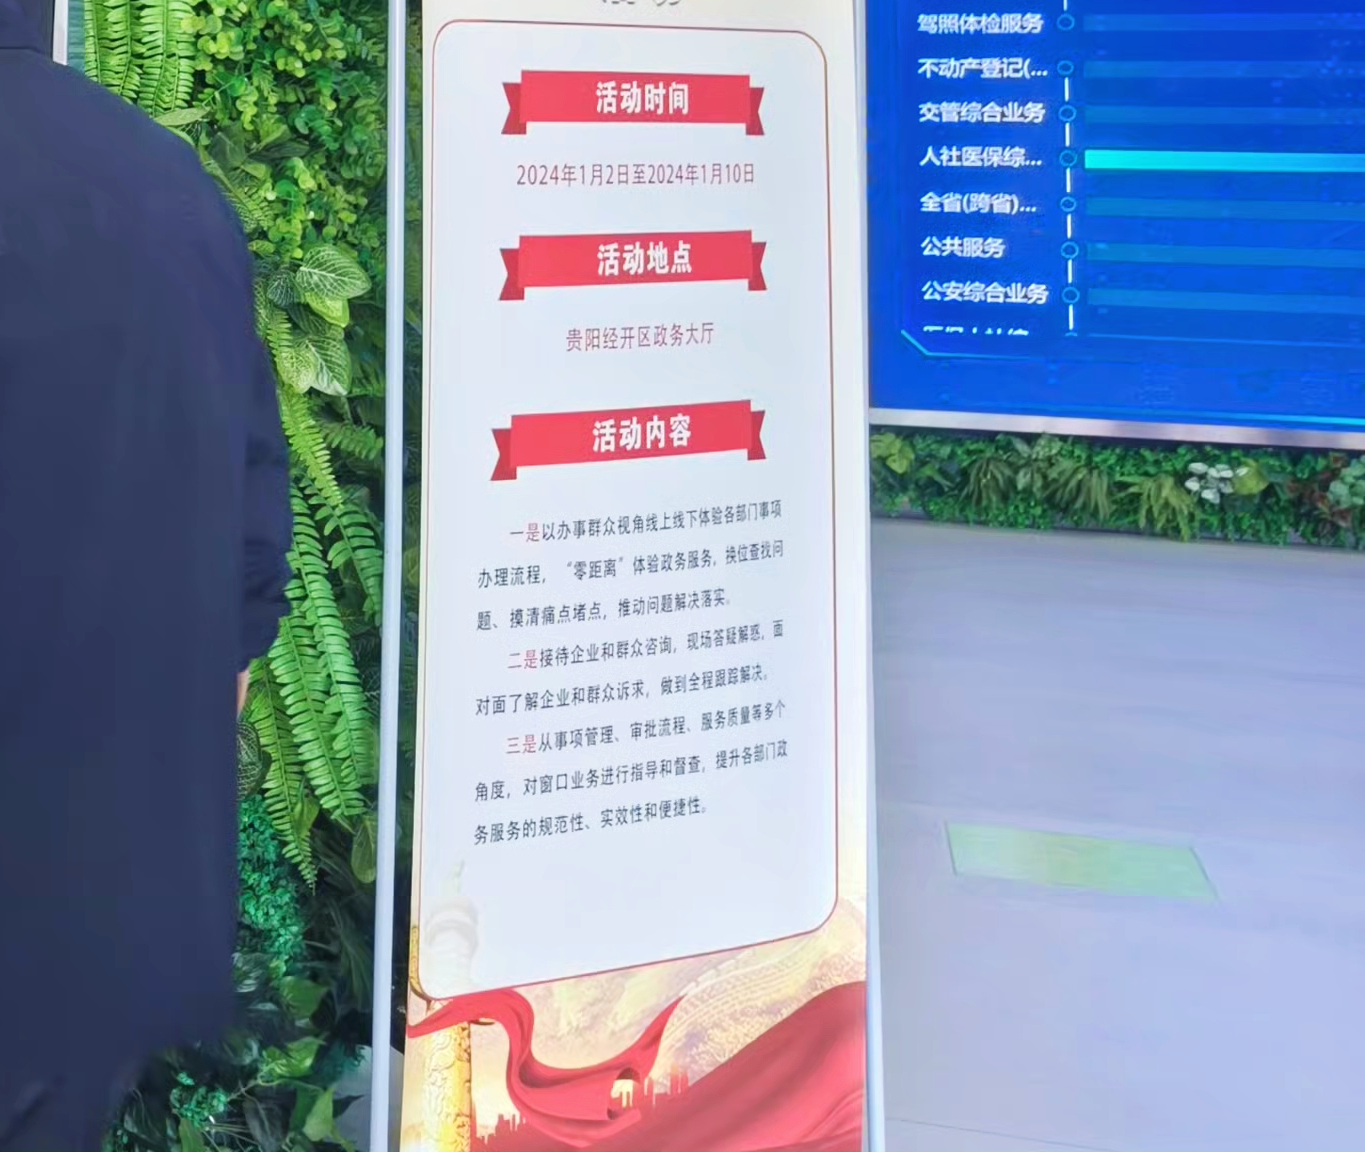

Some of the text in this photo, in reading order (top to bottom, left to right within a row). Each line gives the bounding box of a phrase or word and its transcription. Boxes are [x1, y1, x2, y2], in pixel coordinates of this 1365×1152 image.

[917, 12, 1045, 35] 驾照体检服务
[596, 80, 689, 115] 活动时间
[918, 101, 1046, 124] 交管综合业务
[516, 162, 756, 188] 2024年1月2日至2024年1月10日
[597, 240, 693, 277] 活动地点
[920, 235, 1007, 259] 公共服务
[921, 280, 1050, 305] 公安综合业务
[565, 322, 715, 353] 贵阳经开区政务大厅
[593, 414, 692, 452] 活动内容
[509, 499, 782, 543] 一是以办事群众视角线上线下体验各部门事项
